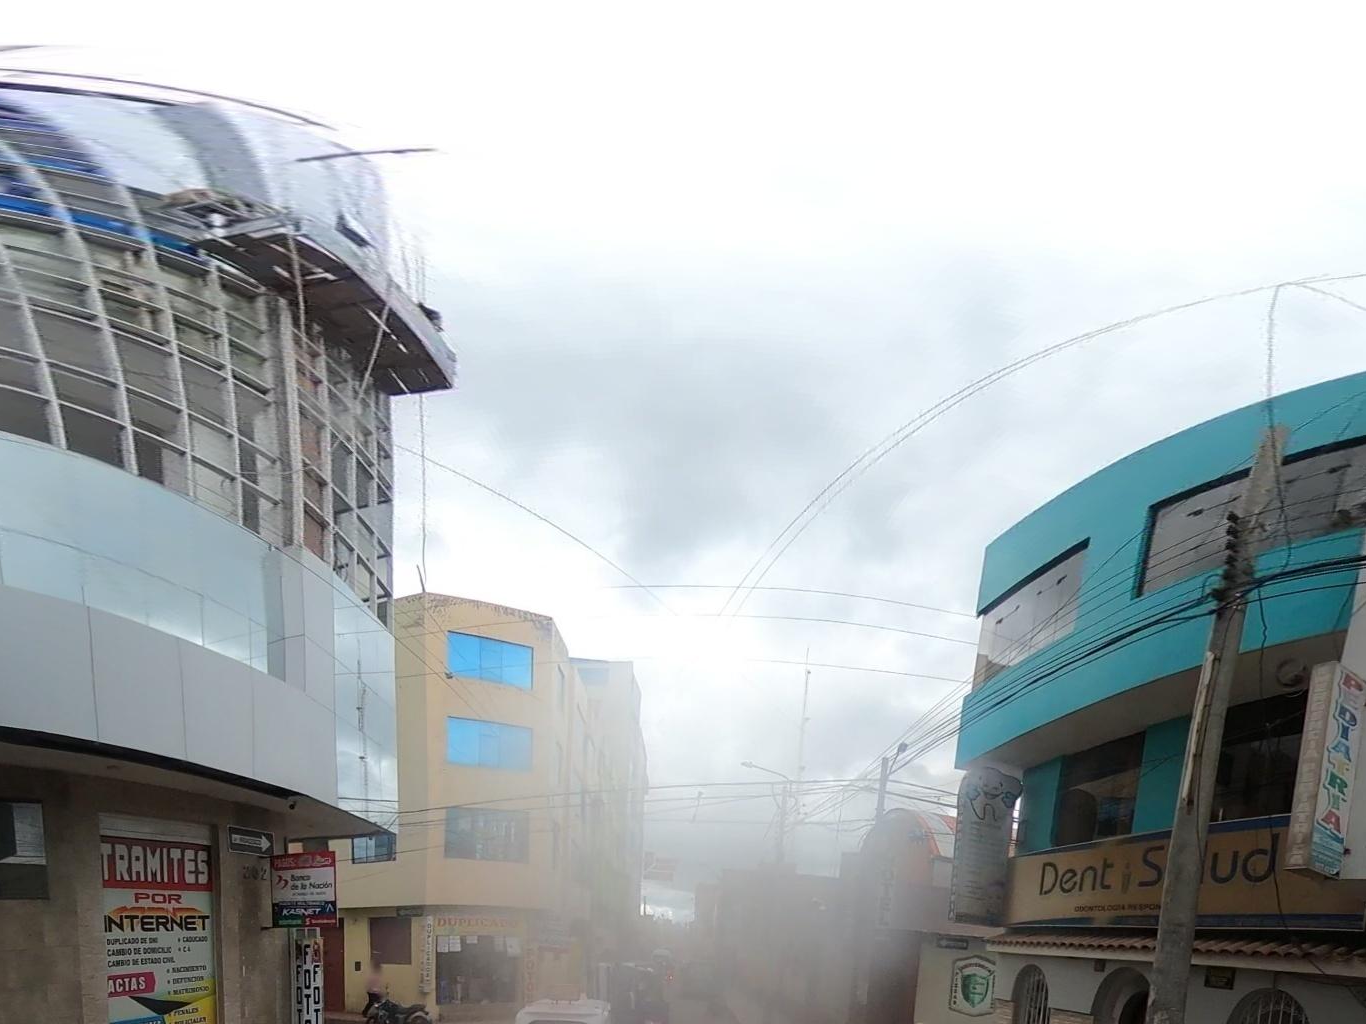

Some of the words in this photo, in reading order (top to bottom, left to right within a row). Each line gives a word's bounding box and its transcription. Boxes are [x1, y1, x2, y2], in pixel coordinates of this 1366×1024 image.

[100, 842, 209, 885] TRAMITES
[1039, 858, 1114, 895] Dent
[1138, 833, 1280, 887] Slud
[133, 892, 183, 904] POR
[103, 914, 210, 933] INTERNET
[106, 938, 140, 946] DUPLICADO
[140, 937, 147, 945] DE
[107, 947, 132, 957] CAMBIO
[134, 947, 142, 955] DE
[107, 959, 131, 968] CAMBIO
[132, 958, 140, 966] DE
[140, 957, 162, 965] ESTADO
[108, 976, 146, 993] ACTAS
